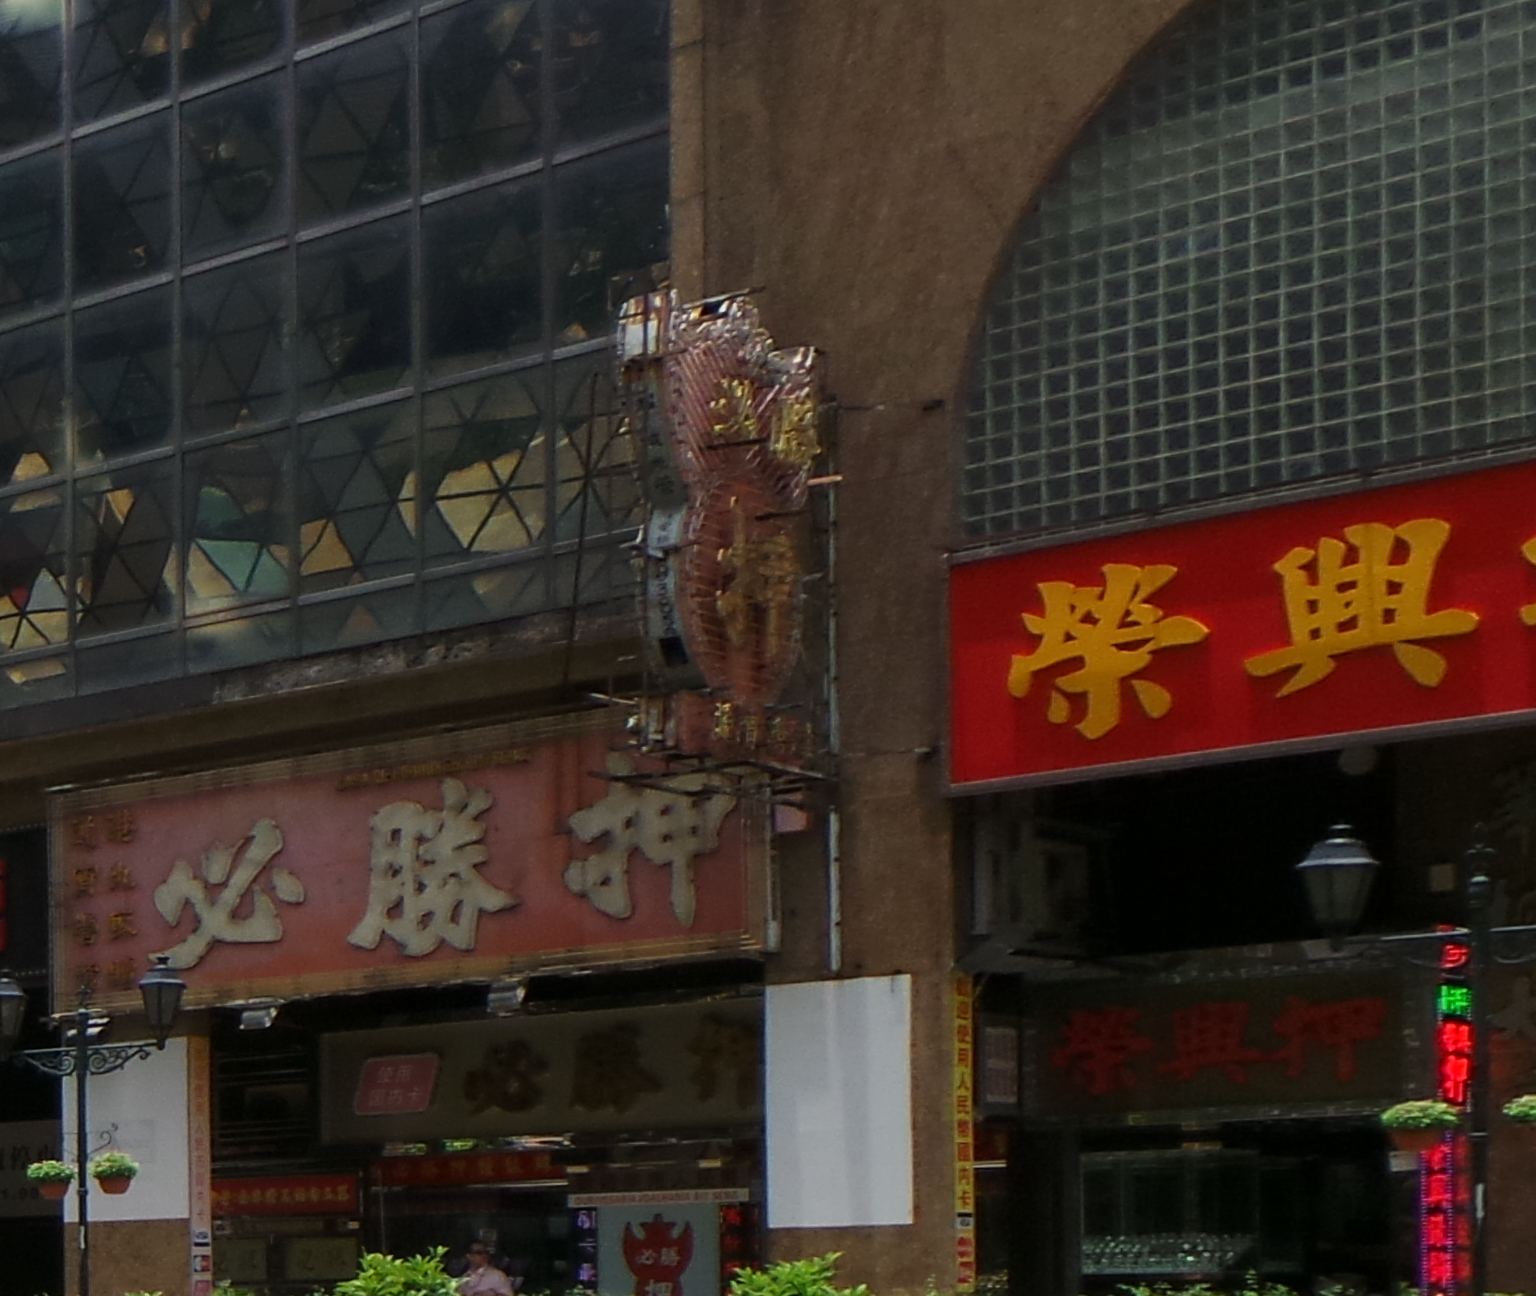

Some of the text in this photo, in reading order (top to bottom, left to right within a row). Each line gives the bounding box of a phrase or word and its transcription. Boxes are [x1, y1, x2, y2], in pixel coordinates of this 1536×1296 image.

[1008, 518, 1536, 740] 榮興
[149, 756, 736, 969] 必勝押
[1049, 996, 1387, 1096] 榮興押
